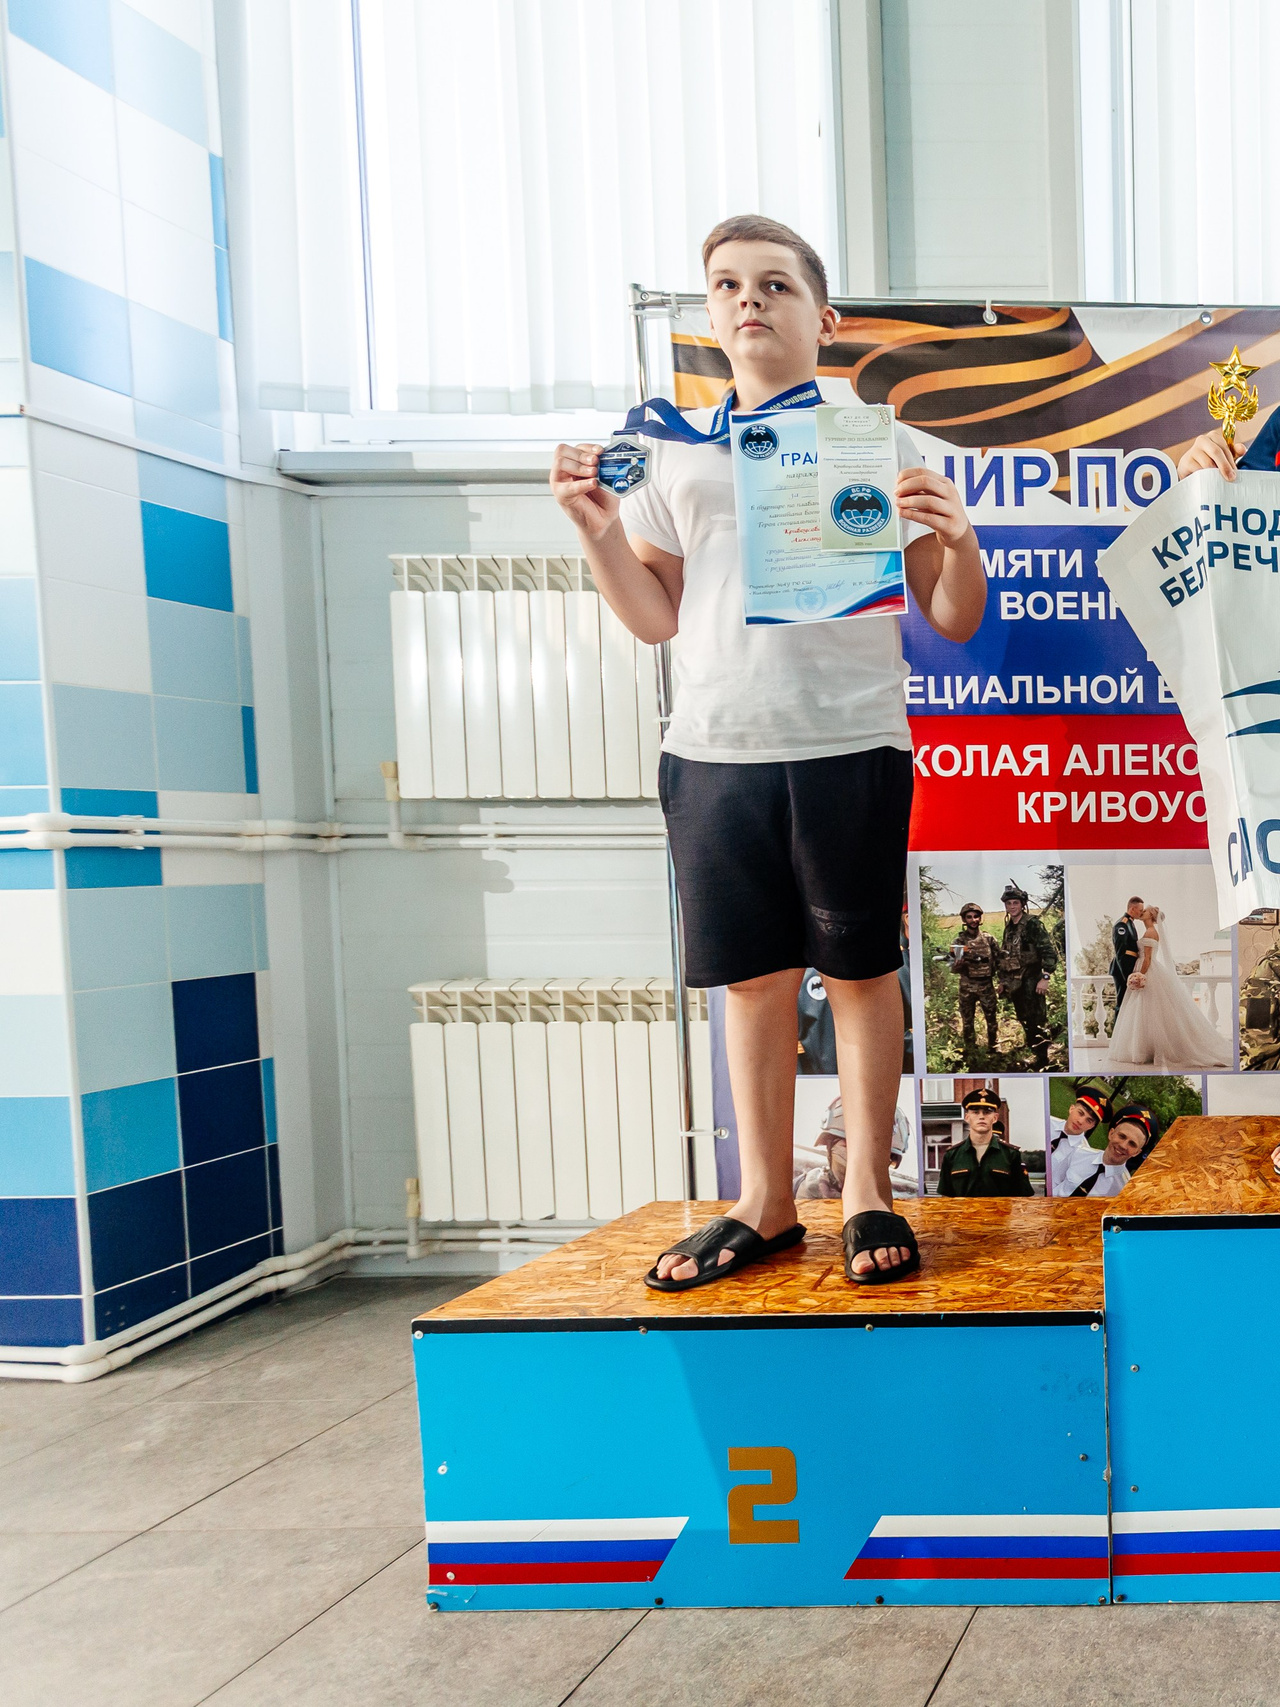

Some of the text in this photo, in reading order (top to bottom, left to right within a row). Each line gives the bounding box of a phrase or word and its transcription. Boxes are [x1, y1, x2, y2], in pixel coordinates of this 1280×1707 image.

[922, 456, 1171, 507] ИР ПО
[728, 1446, 799, 1544] 2
